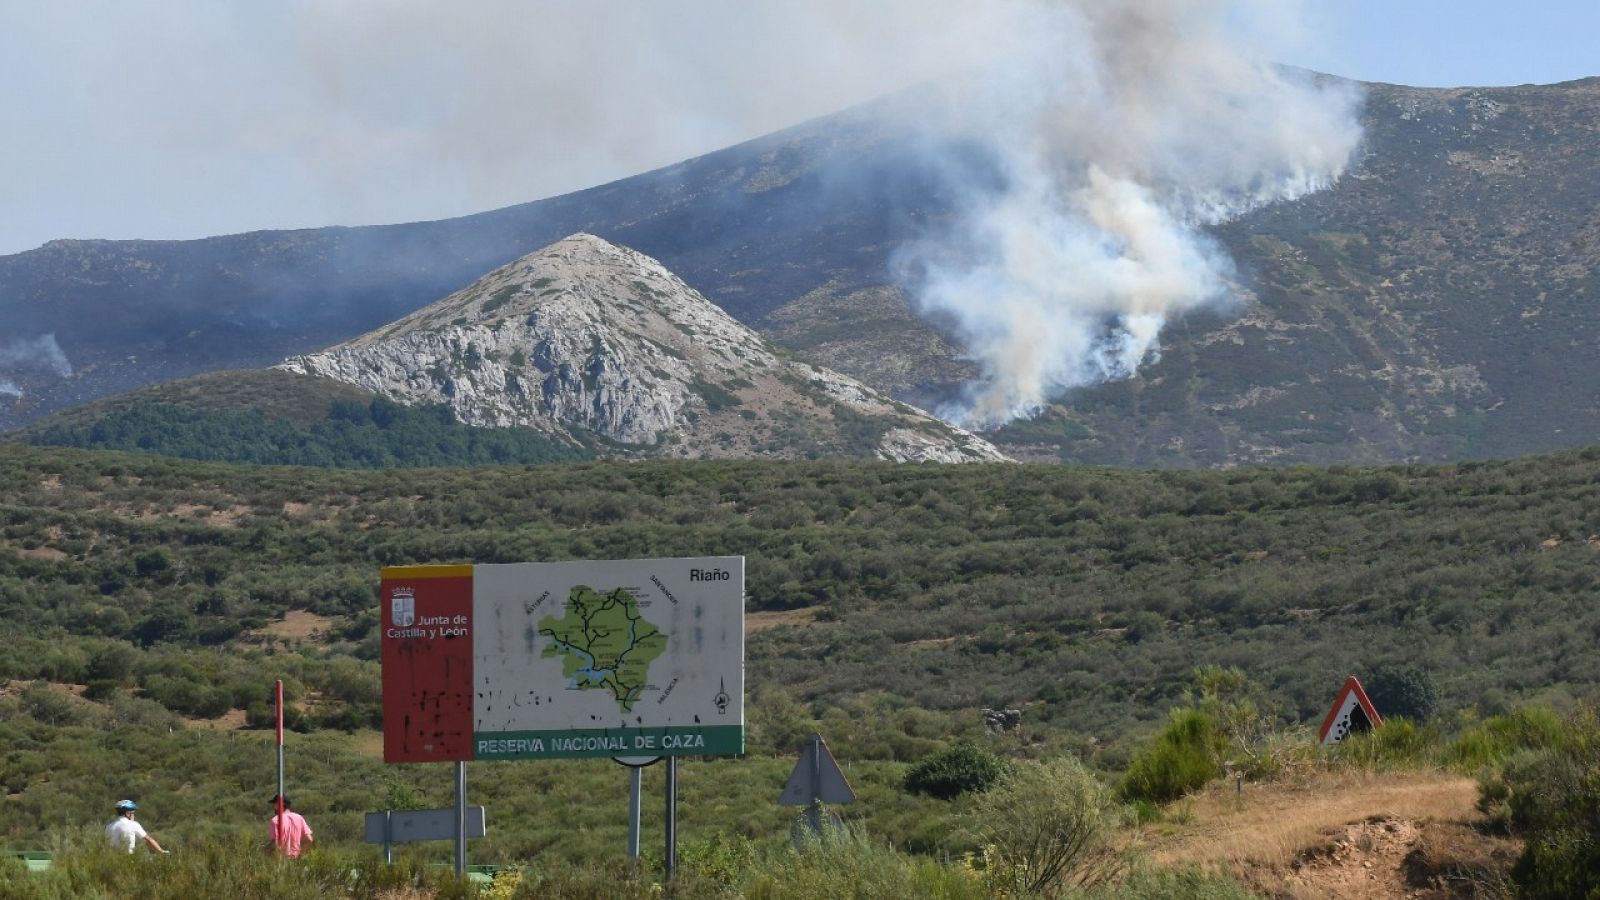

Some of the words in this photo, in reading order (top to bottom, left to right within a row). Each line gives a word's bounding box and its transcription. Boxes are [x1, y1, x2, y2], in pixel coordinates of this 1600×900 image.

[690, 568, 729, 581] Riaño
[418, 616, 449, 626] Junta
[453, 615, 467, 625] de
[387, 628, 426, 638] Castilla
[430, 630, 436, 639] y
[440, 626, 467, 637] León
[478, 739, 544, 753] RESERVA
[552, 736, 628, 751] NACIONAL
[635, 735, 655, 749] DE
[662, 734, 704, 749] CAZA
